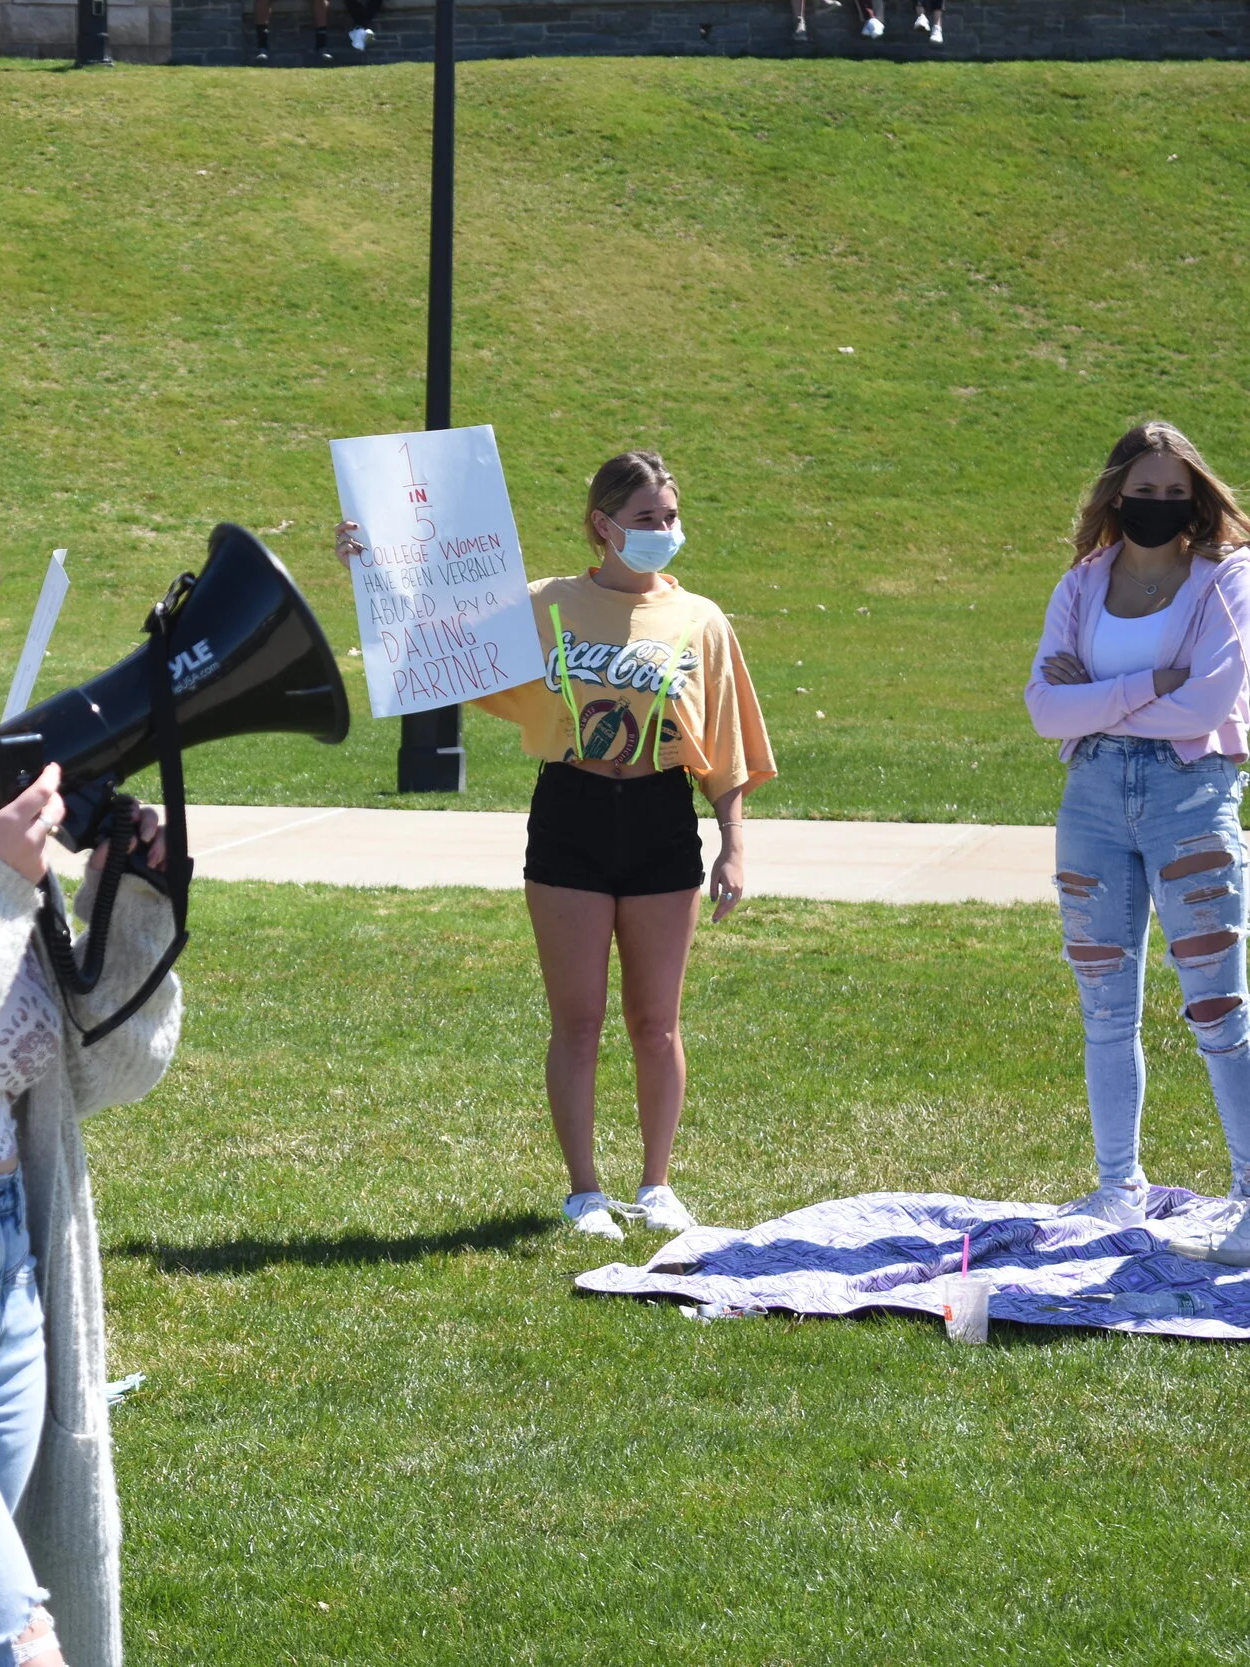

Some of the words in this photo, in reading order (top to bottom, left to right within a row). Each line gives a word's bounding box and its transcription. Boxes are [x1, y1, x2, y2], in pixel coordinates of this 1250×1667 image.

[398, 442, 428, 487] 1
[409, 488, 427, 503] IN
[411, 505, 436, 541] 5
[359, 543, 429, 568] COLLEGE
[439, 533, 501, 561] WOMEN
[363, 570, 396, 594] HAVE
[401, 567, 434, 590] BEEN
[437, 550, 508, 586] VERBALLY
[370, 594, 436, 626] ABUSED
[454, 594, 481, 613] by
[486, 591, 498, 606] a
[381, 612, 477, 663] DATING
[167, 638, 214, 680] YLE
[392, 640, 509, 706] PARTNER
